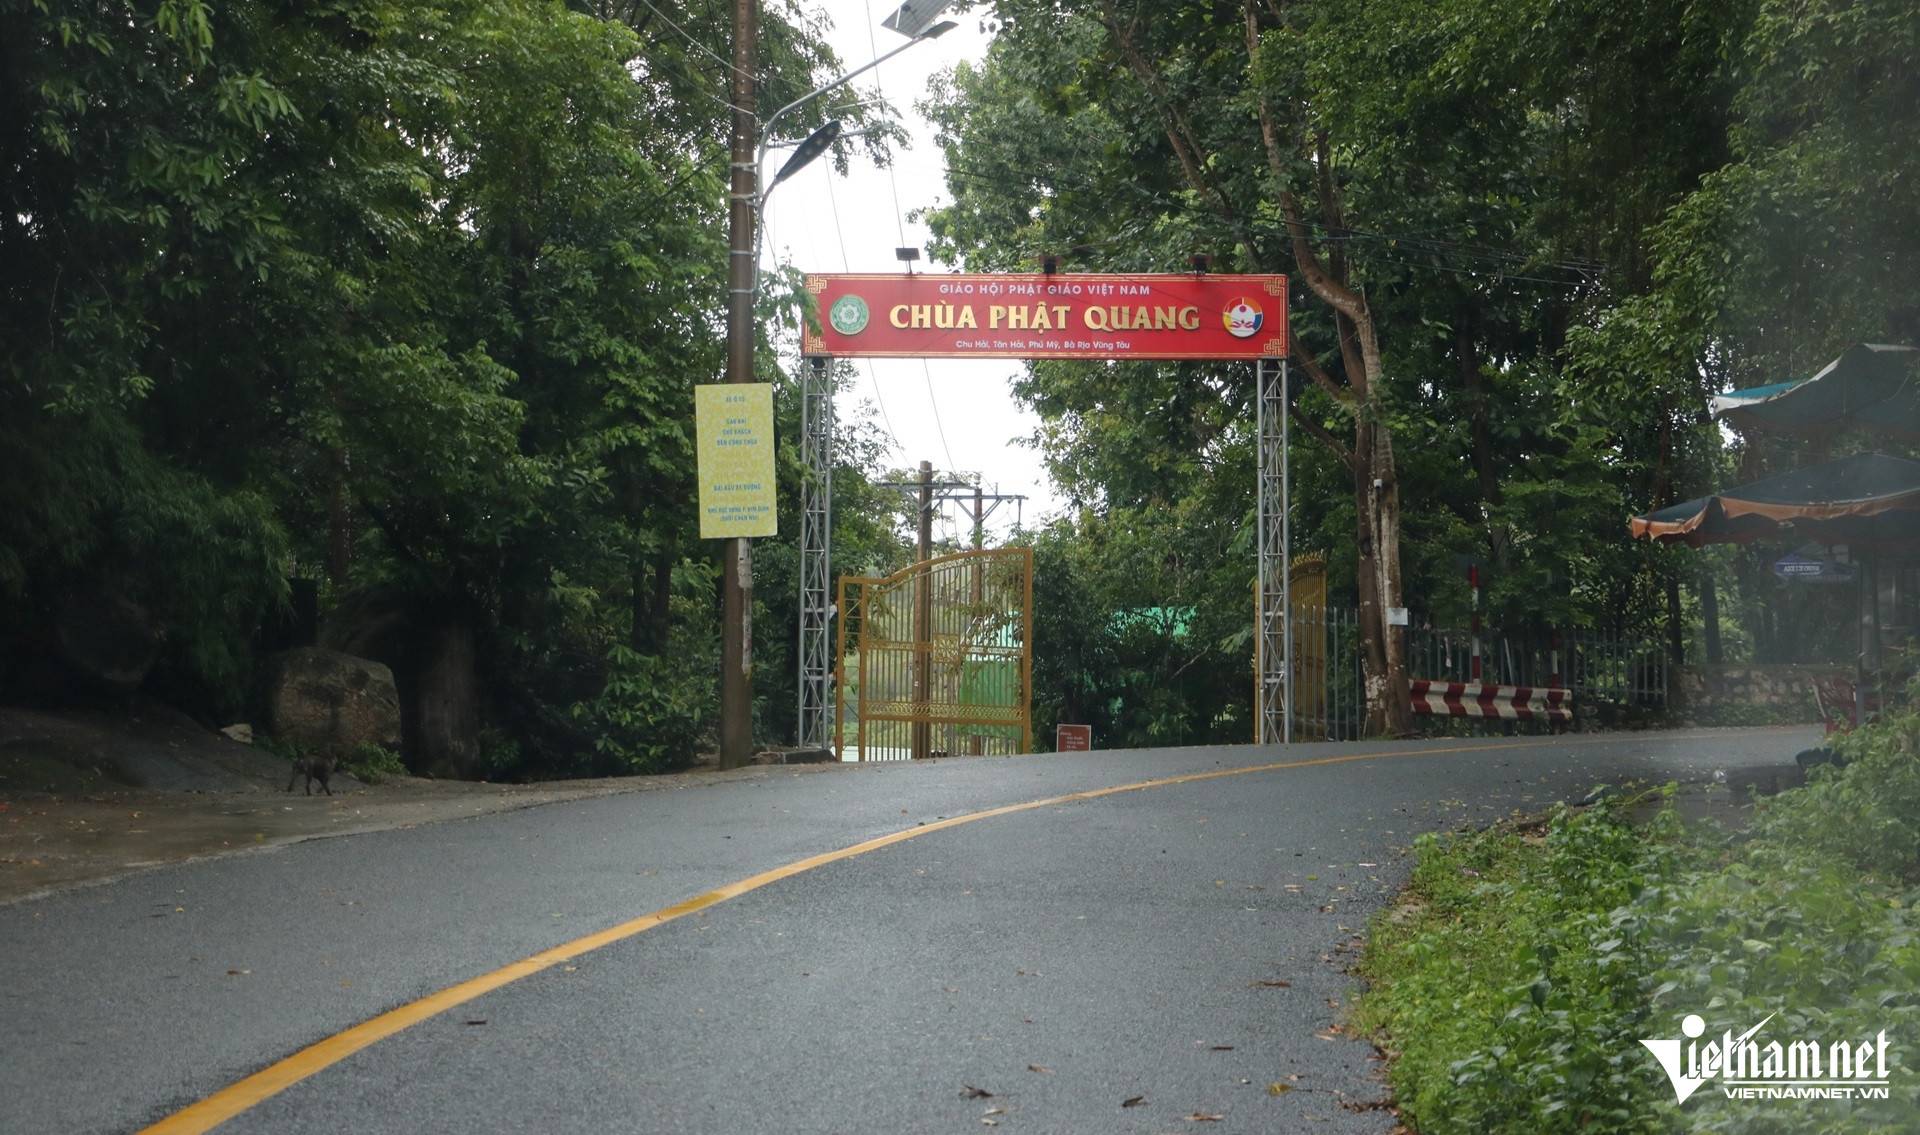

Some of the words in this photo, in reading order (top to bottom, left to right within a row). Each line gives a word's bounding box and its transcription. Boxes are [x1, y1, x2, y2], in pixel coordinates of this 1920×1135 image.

[939, 282, 974, 294] GIÁO
[979, 282, 1004, 296] HỘI
[1009, 282, 1043, 296] PHẬT
[1047, 282, 1082, 295] GIÁO
[1087, 282, 1115, 297] VIỆT
[1119, 285, 1151, 295] NAM
[889, 300, 979, 329] CHÙA
[989, 301, 1072, 335] PHẬT
[1083, 306, 1201, 333] QUANG
[956, 340, 973, 349] Chu
[1028, 340, 1044, 349] Phú
[1064, 340, 1076, 349] Bà
